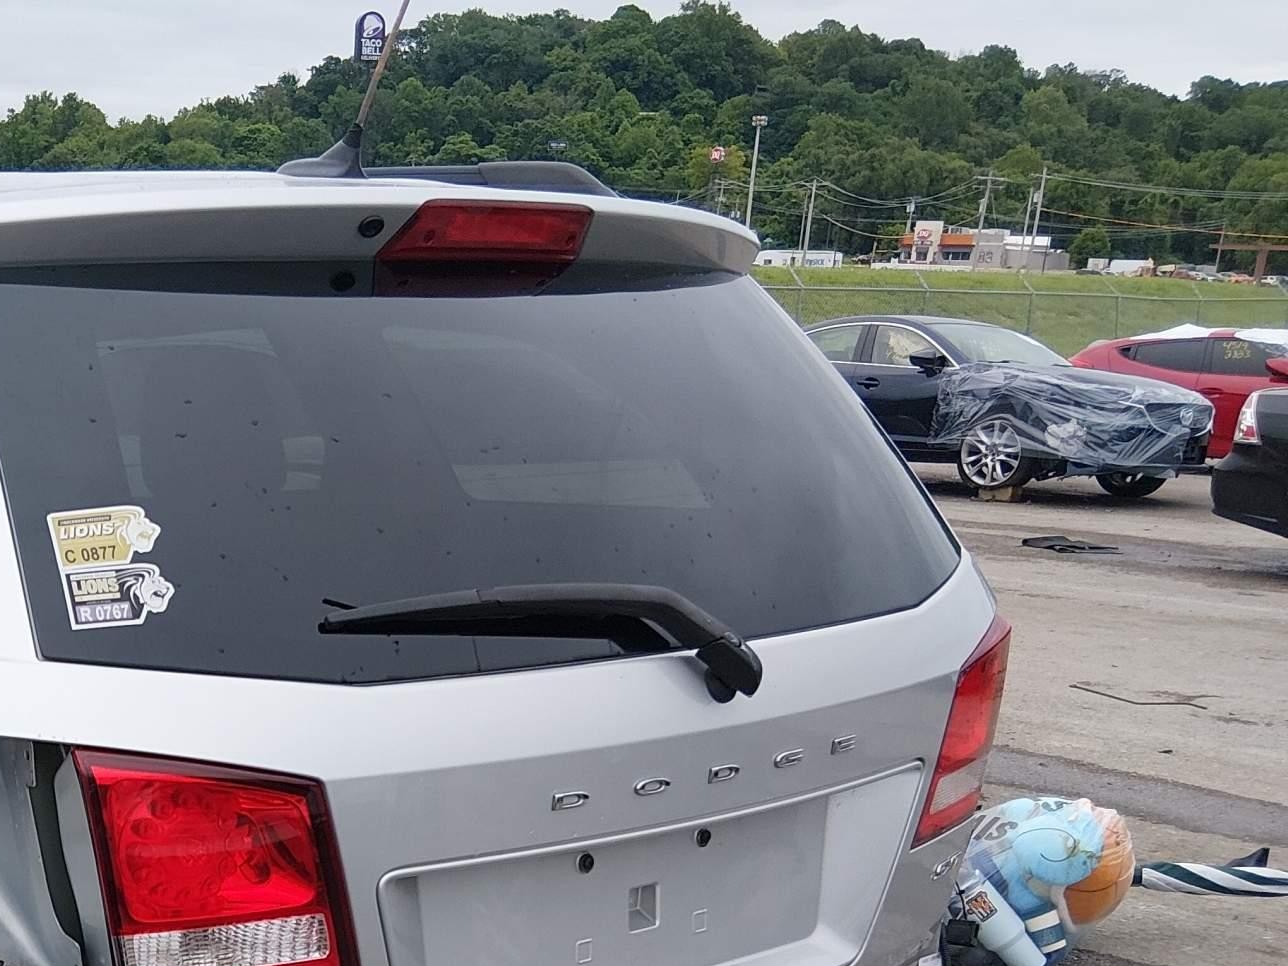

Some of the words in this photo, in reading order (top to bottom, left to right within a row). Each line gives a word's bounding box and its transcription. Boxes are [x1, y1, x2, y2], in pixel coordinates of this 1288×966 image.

[361, 38, 382, 47] TACO
[362, 47, 382, 55] BELL
[58, 521, 116, 540] LIONS
[65, 549, 76, 563] C
[81, 545, 116, 562] 0877
[71, 576, 119, 595] LIONS
[81, 607, 93, 623] R
[96, 604, 129, 622] 0767
[551, 734, 857, 812] DODGE
